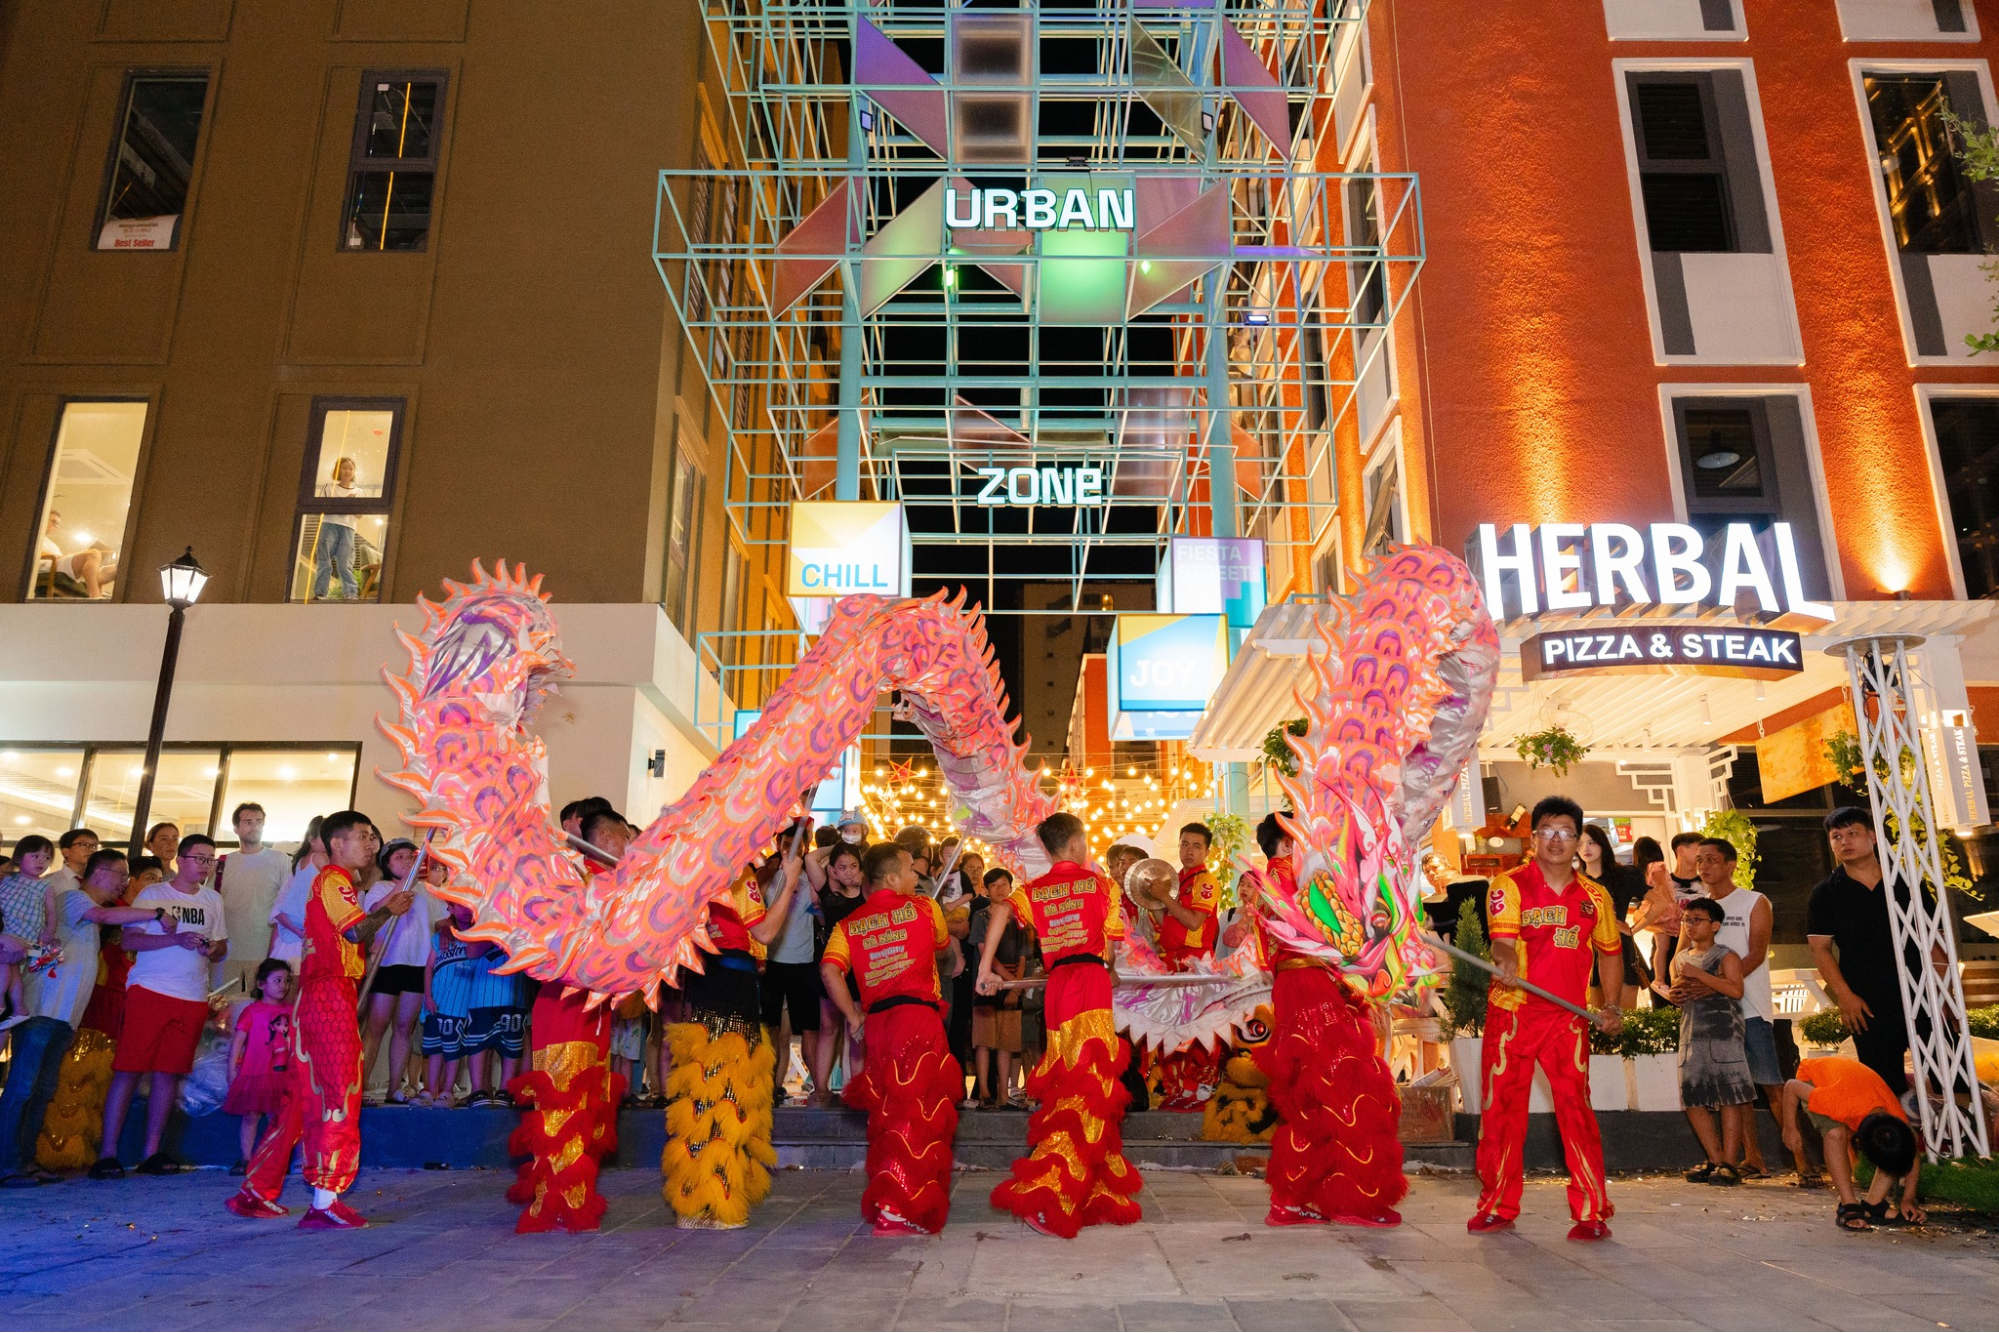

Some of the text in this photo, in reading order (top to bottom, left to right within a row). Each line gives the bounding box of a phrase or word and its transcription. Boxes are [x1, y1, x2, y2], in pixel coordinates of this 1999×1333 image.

[946, 188, 1135, 231] URBAN
[115, 238, 155, 247] Best Seller
[1176, 545, 1243, 561] FIESTA
[801, 563, 888, 587] CHILL
[1177, 565, 1251, 581] STREET
[1479, 522, 1836, 622] HERBAL
[1544, 634, 1798, 664] PIZZA & STEAK
[1129, 659, 1195, 688] JOY
[1953, 729, 1968, 756] STEAK
[1961, 764, 1972, 788] PIZZA
[1966, 789, 1978, 821] HERBAL
[182, 907, 204, 926] NBA
[501, 1014, 521, 1033] 90
